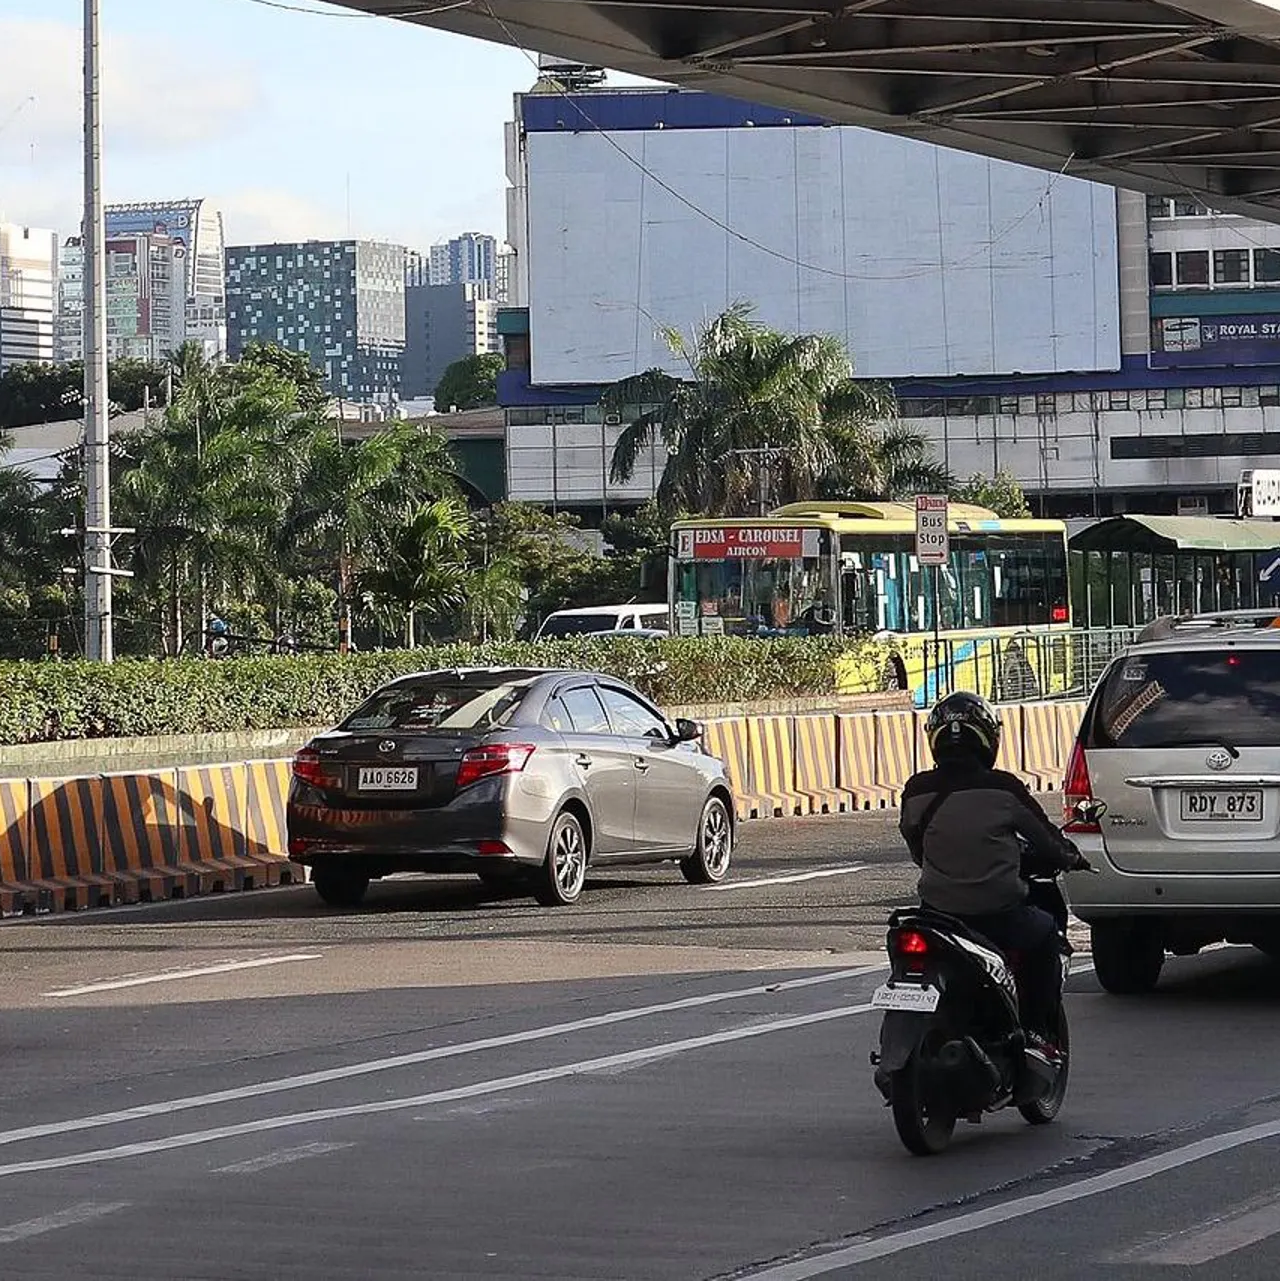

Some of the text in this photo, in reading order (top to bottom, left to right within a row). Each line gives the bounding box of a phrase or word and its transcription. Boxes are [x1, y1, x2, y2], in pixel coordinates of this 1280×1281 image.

[1219, 325, 1257, 336] ROYAL
[921, 516, 943, 527] Bus
[695, 529, 726, 544] EDSA
[738, 529, 801, 543] CAROUSEL
[919, 533, 945, 546] Stop
[726, 546, 768, 556] AIRCON
[386, 771, 415, 784] 6626
[1189, 796, 1255, 812] RDY 873
